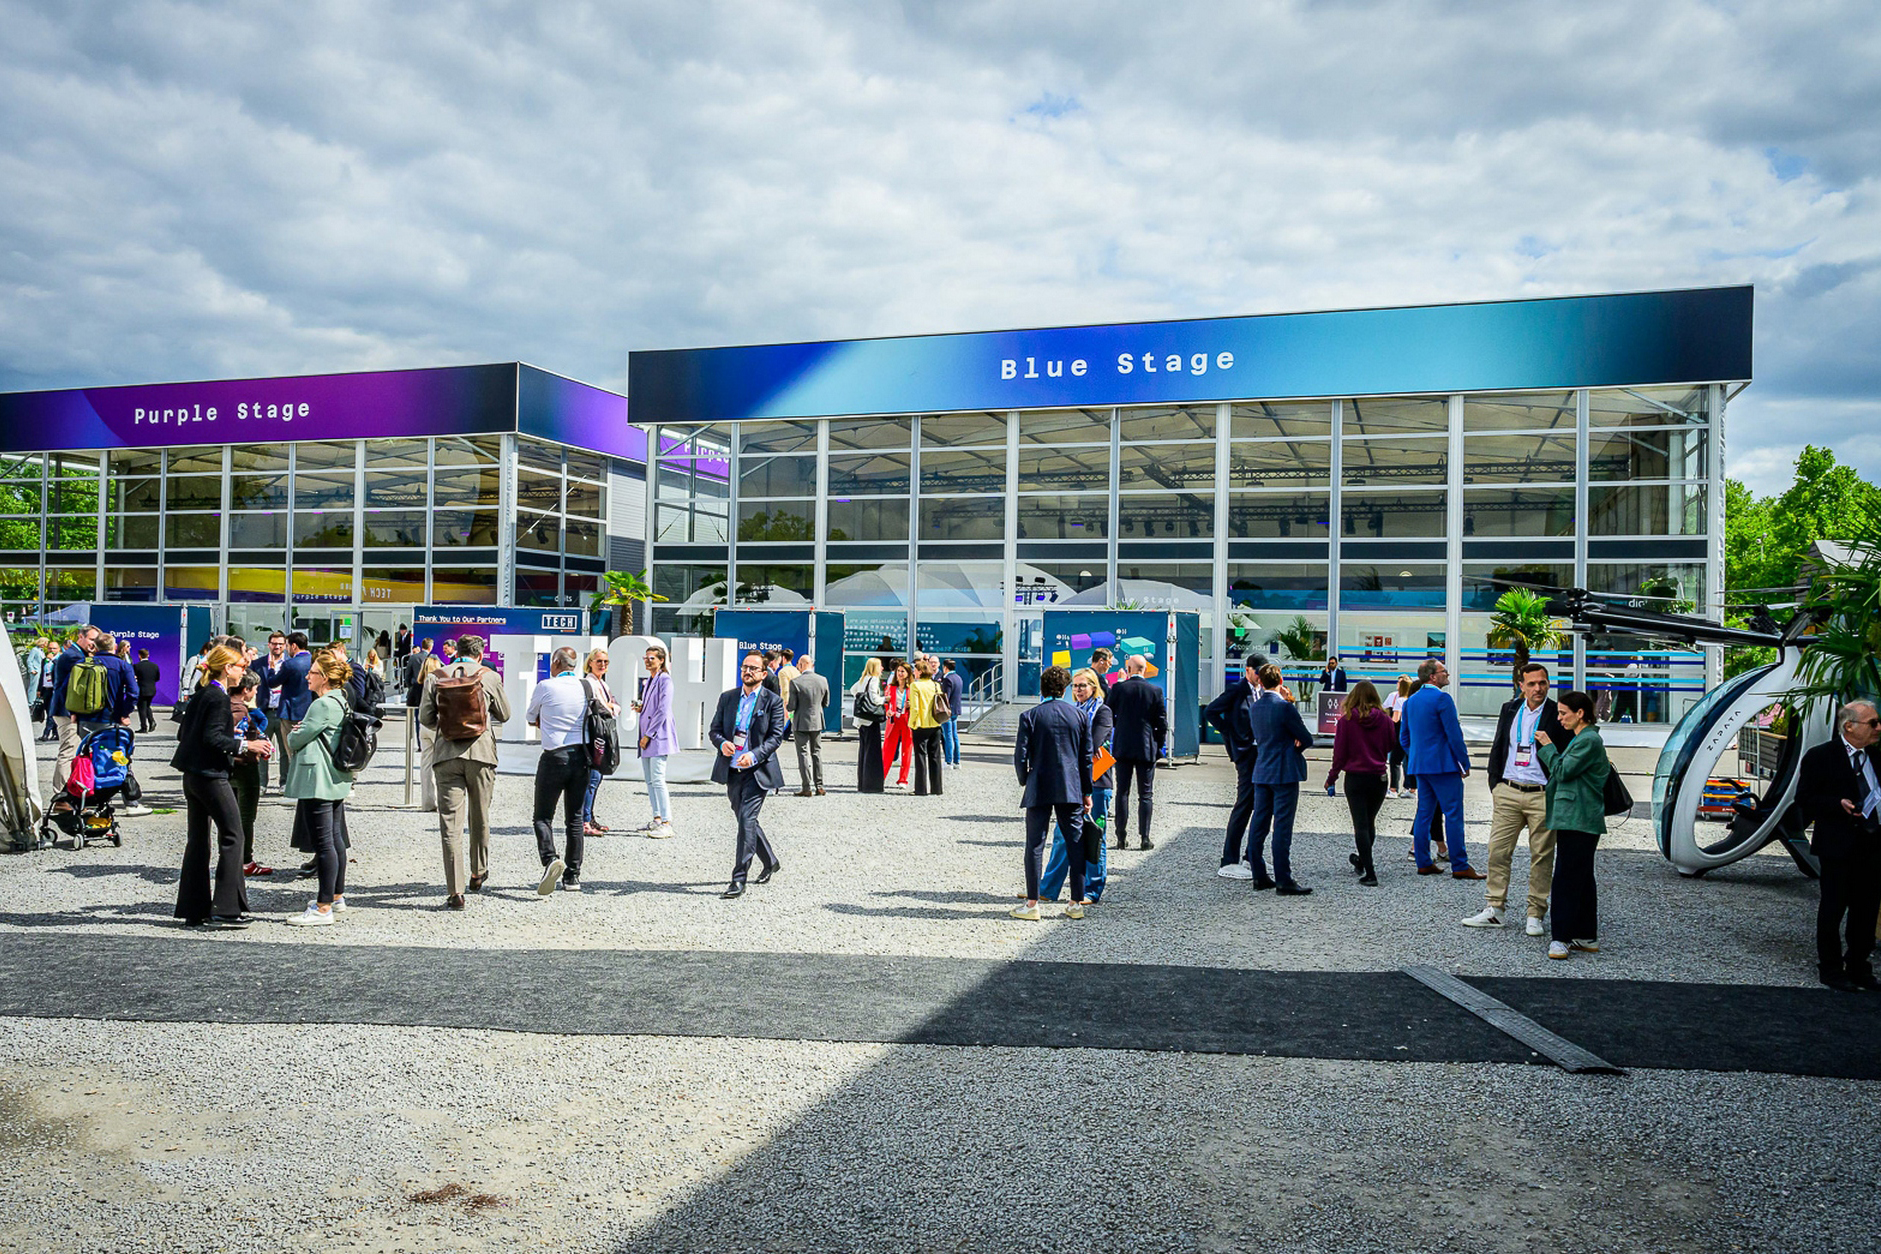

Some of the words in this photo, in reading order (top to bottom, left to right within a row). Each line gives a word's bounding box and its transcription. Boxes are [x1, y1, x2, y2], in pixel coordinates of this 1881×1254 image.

[1001, 357, 1088, 380] Blue
[1117, 351, 1234, 376] Stage
[134, 404, 218, 426] Purple
[237, 402, 309, 422] Stage
[418, 614, 438, 622] Thank
[476, 616, 506, 624] Partners
[545, 617, 574, 627] TECH
[109, 630, 135, 639] Purple
[138, 630, 160, 639] Stage
[739, 641, 757, 650] Blue
[760, 641, 782, 651] Stage
[1706, 710, 1741, 751] ZAPATA
